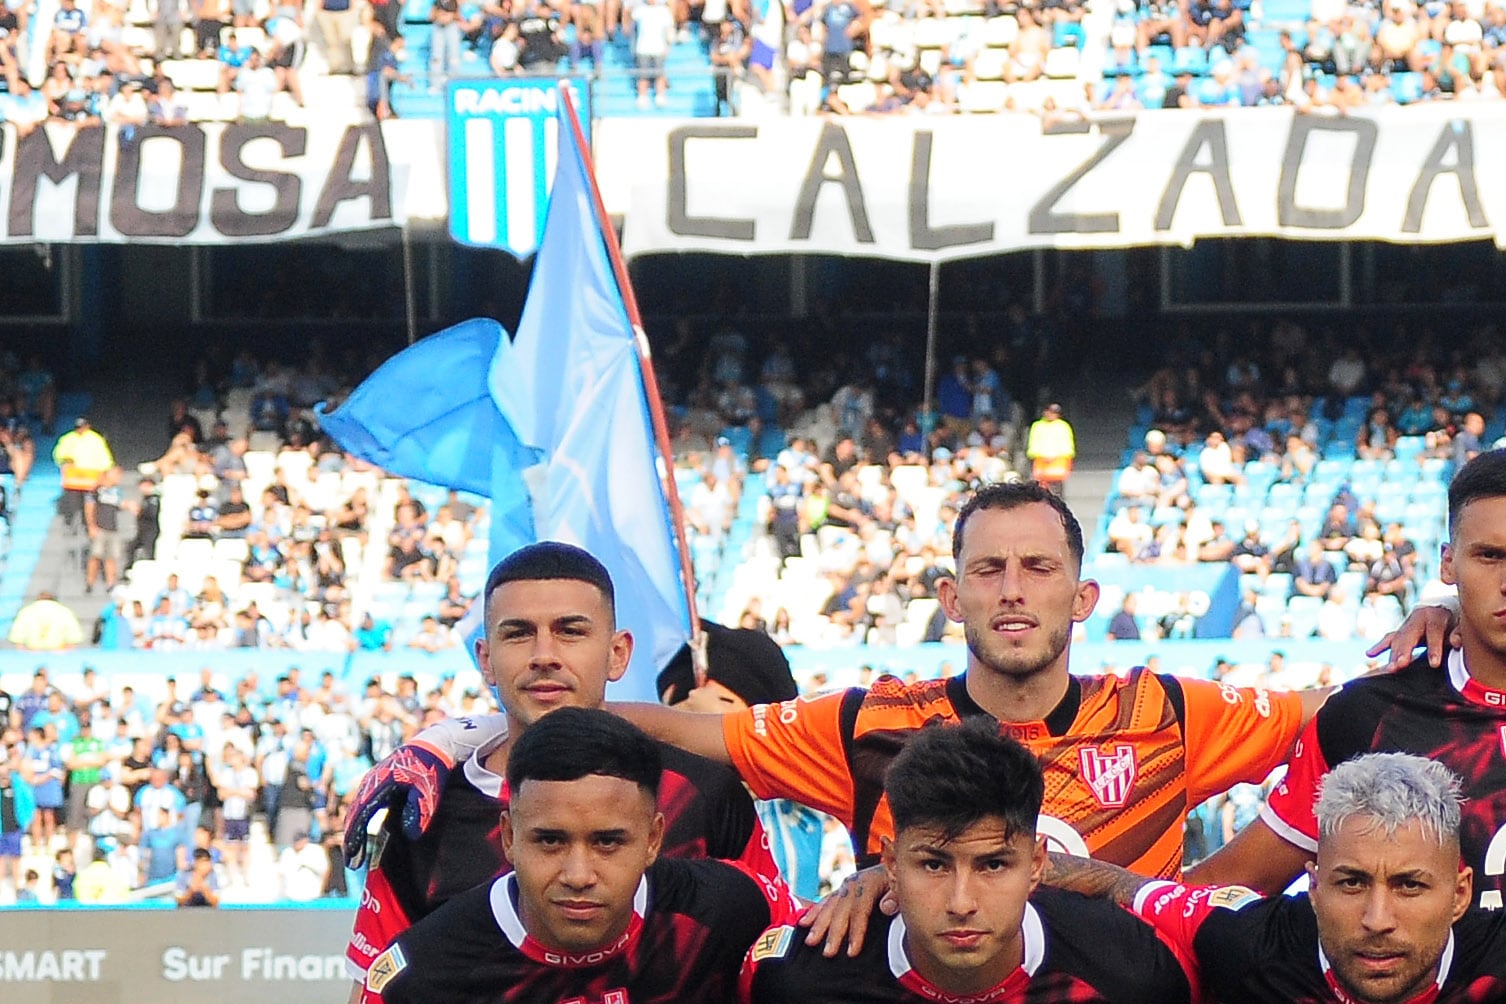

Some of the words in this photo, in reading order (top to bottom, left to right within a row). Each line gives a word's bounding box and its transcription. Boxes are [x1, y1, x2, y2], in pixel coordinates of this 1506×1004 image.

[0, 120, 392, 239] MOSA
[667, 115, 1488, 250] CALZADA
[162, 947, 229, 981] Sur
[241, 947, 348, 981] Finan
[545, 934, 630, 965] GIVOVA
[921, 985, 1006, 1004] GIVOVA
